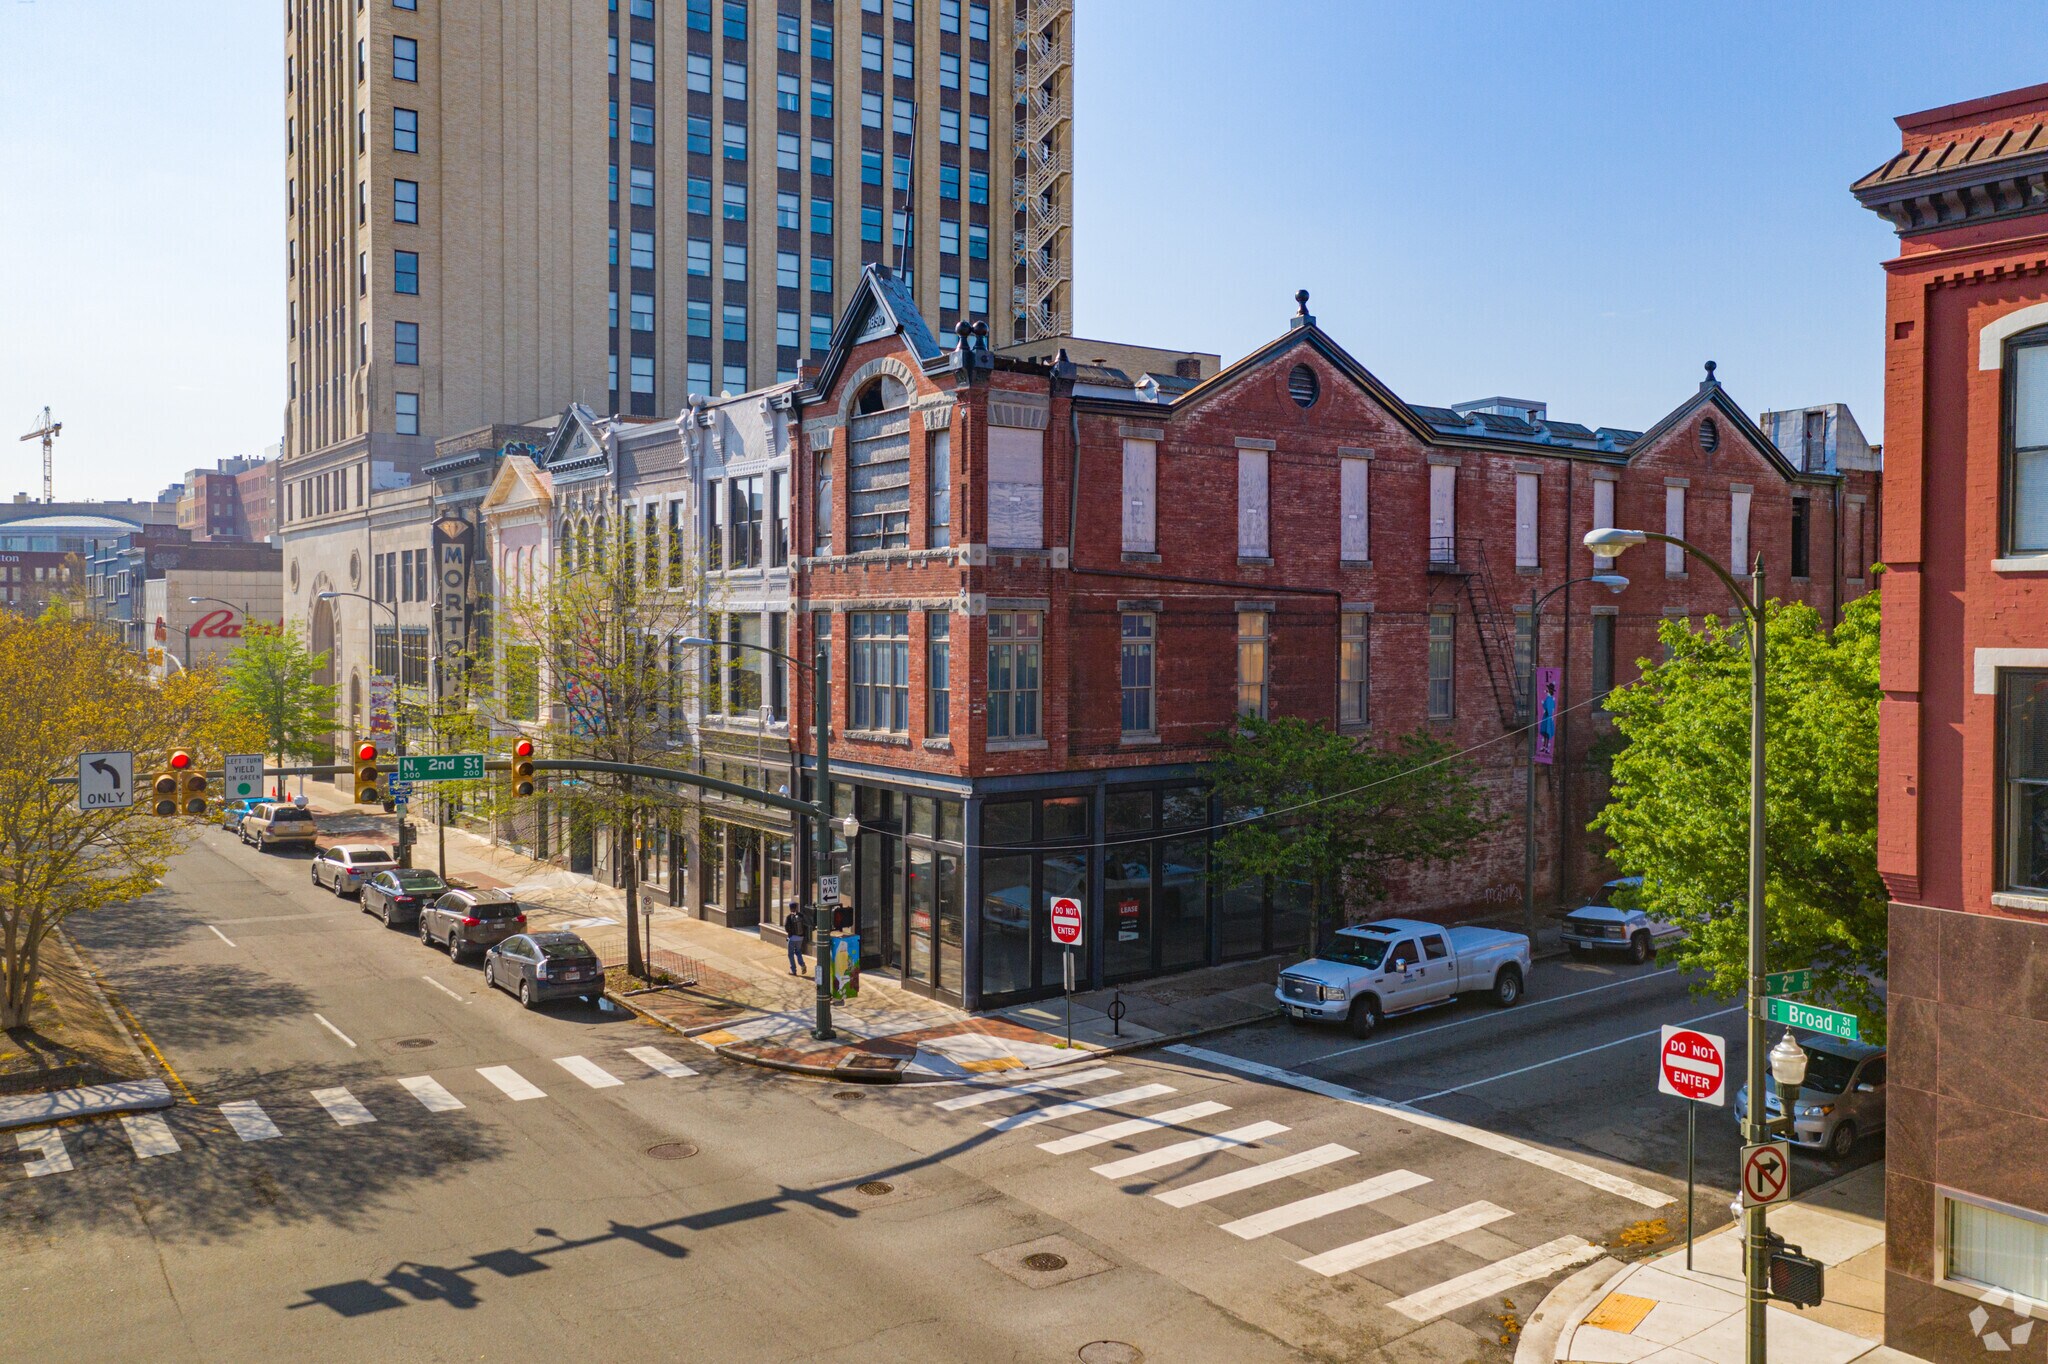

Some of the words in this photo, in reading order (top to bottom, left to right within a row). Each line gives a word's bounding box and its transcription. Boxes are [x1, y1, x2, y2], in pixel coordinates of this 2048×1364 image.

[234, 765, 255, 773] YIELD
[403, 759, 418, 771] N.
[428, 758, 455, 771] 2nd
[463, 757, 480, 769] St
[403, 771, 420, 779] 300
[87, 792, 125, 804] ONLY
[822, 877, 837, 886] ONE
[822, 886, 838, 894] WAY
[1055, 906, 1063, 914] DO
[1065, 907, 1077, 916] NOT
[1120, 905, 1138, 914] LEASE
[1057, 926, 1076, 936] ENTER
[1766, 981, 1771, 992] S
[1782, 974, 1795, 992] 2nd
[1803, 971, 1809, 980] St
[1771, 1004, 1777, 1015] E
[1788, 1004, 1833, 1032] Broad
[1842, 1016, 1851, 1026] St
[1836, 1025, 1851, 1036] 100
[1670, 1040, 1686, 1053] DO
[1692, 1045, 1715, 1060] NOT
[1673, 1070, 1710, 1090] ENTER
